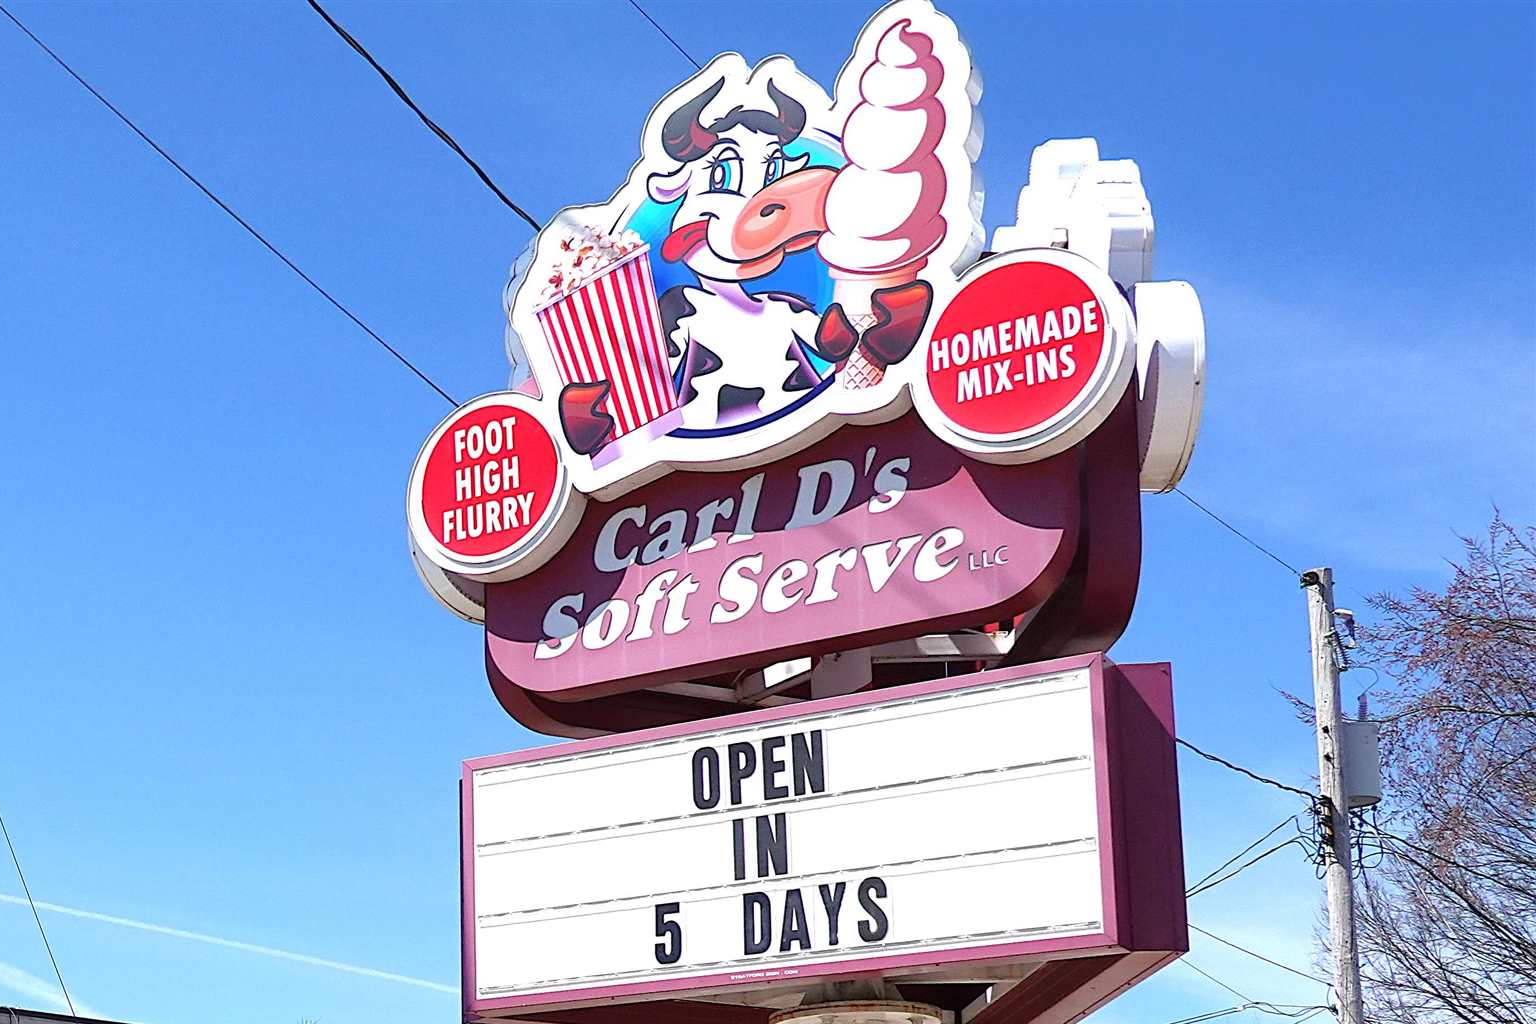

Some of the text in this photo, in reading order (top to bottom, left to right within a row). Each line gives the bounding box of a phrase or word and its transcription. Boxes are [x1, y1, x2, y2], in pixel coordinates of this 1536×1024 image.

[930, 300, 1098, 371] HOMEMADE
[956, 344, 1077, 404] MIX-INS
[453, 417, 517, 460] FOOT
[455, 458, 520, 501] HIGH
[593, 447, 913, 574] Carl D's
[442, 493, 535, 543] FLURRY
[534, 525, 1008, 660] Soft Serve LLC
[691, 729, 825, 810] OPEN
[733, 812, 787, 881] IN
[654, 877, 889, 964] 5 DAYS
